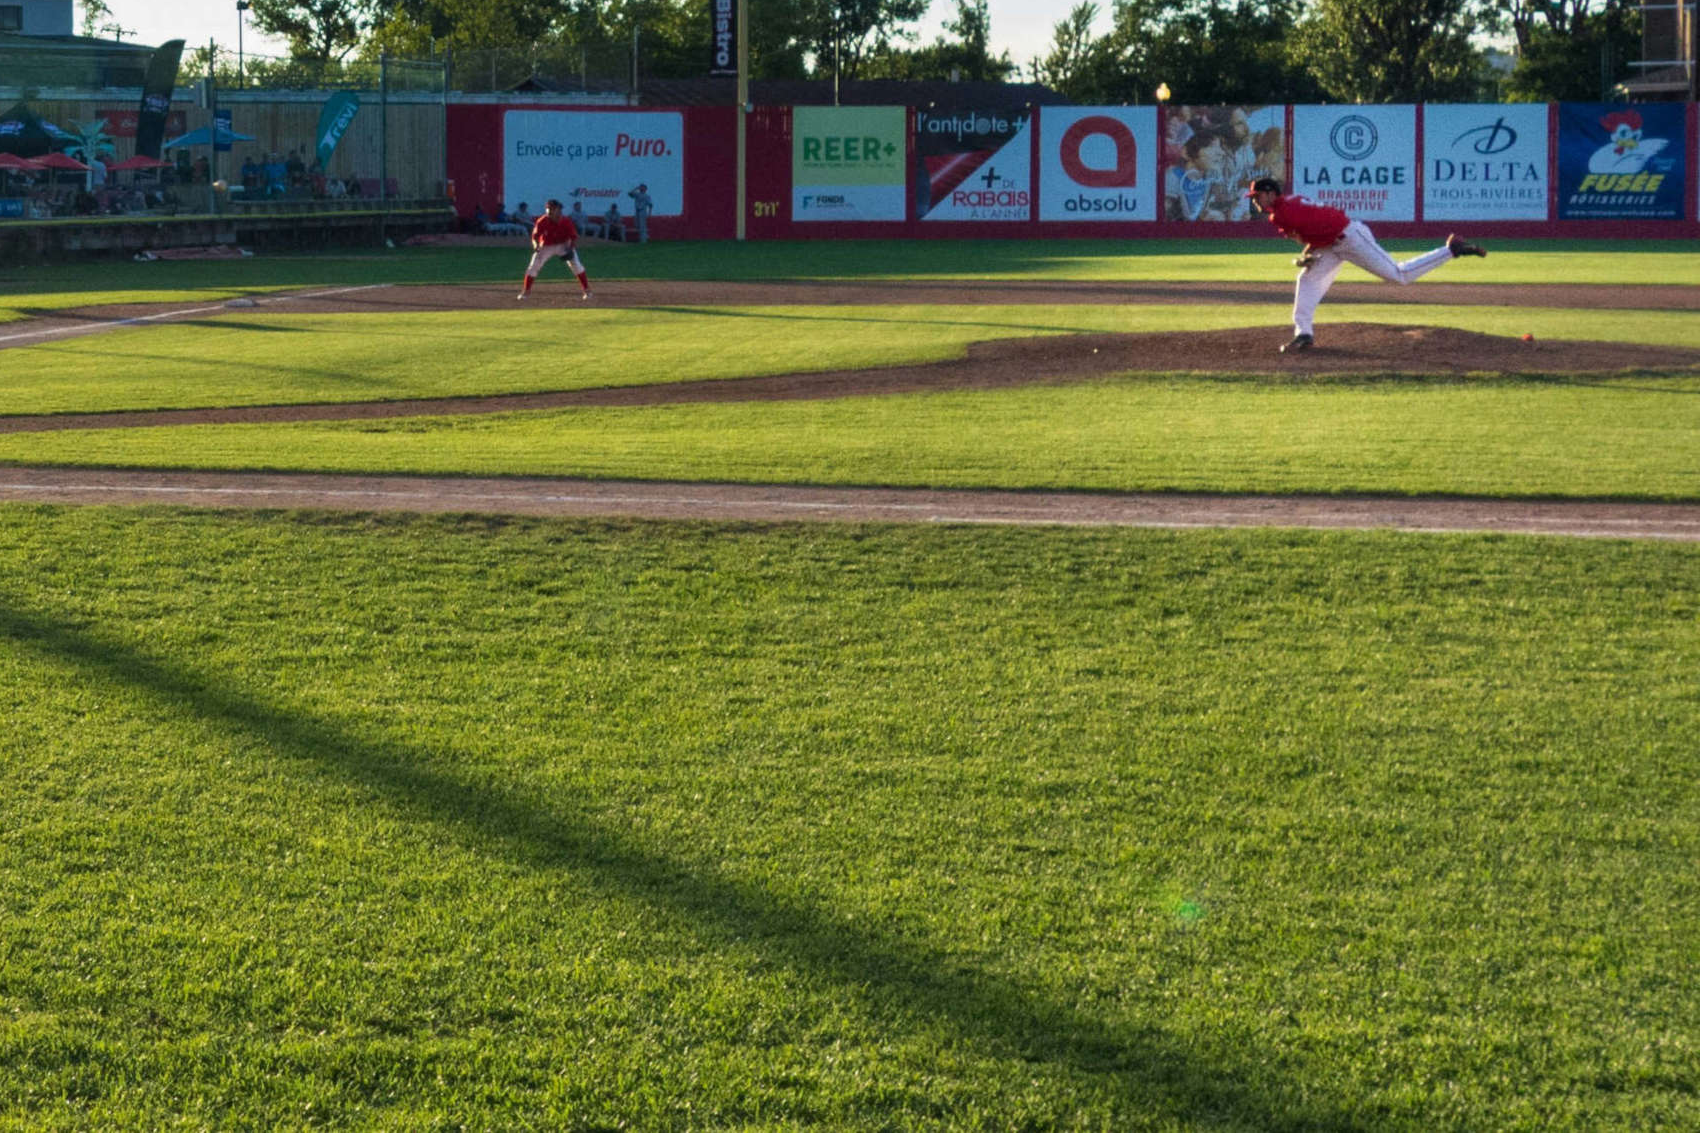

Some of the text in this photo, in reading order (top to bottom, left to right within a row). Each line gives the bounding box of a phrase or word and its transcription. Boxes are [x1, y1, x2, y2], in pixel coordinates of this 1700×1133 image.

[318, 102, 358, 149] Trevi
[516, 133, 672, 160] Envoie ça par Puro.
[803, 137, 896, 161] REER+
[1304, 167, 1405, 185] LA CAGE
[1434, 159, 1540, 181] DELTA
[1578, 170, 1665, 192] FUSÉE
[816, 195, 845, 204] FONDS
[1065, 195, 1137, 213] absolu
[1318, 190, 1388, 200] BRASSERIE
[1431, 188, 1543, 200] TROIS-RIVIÈRES
